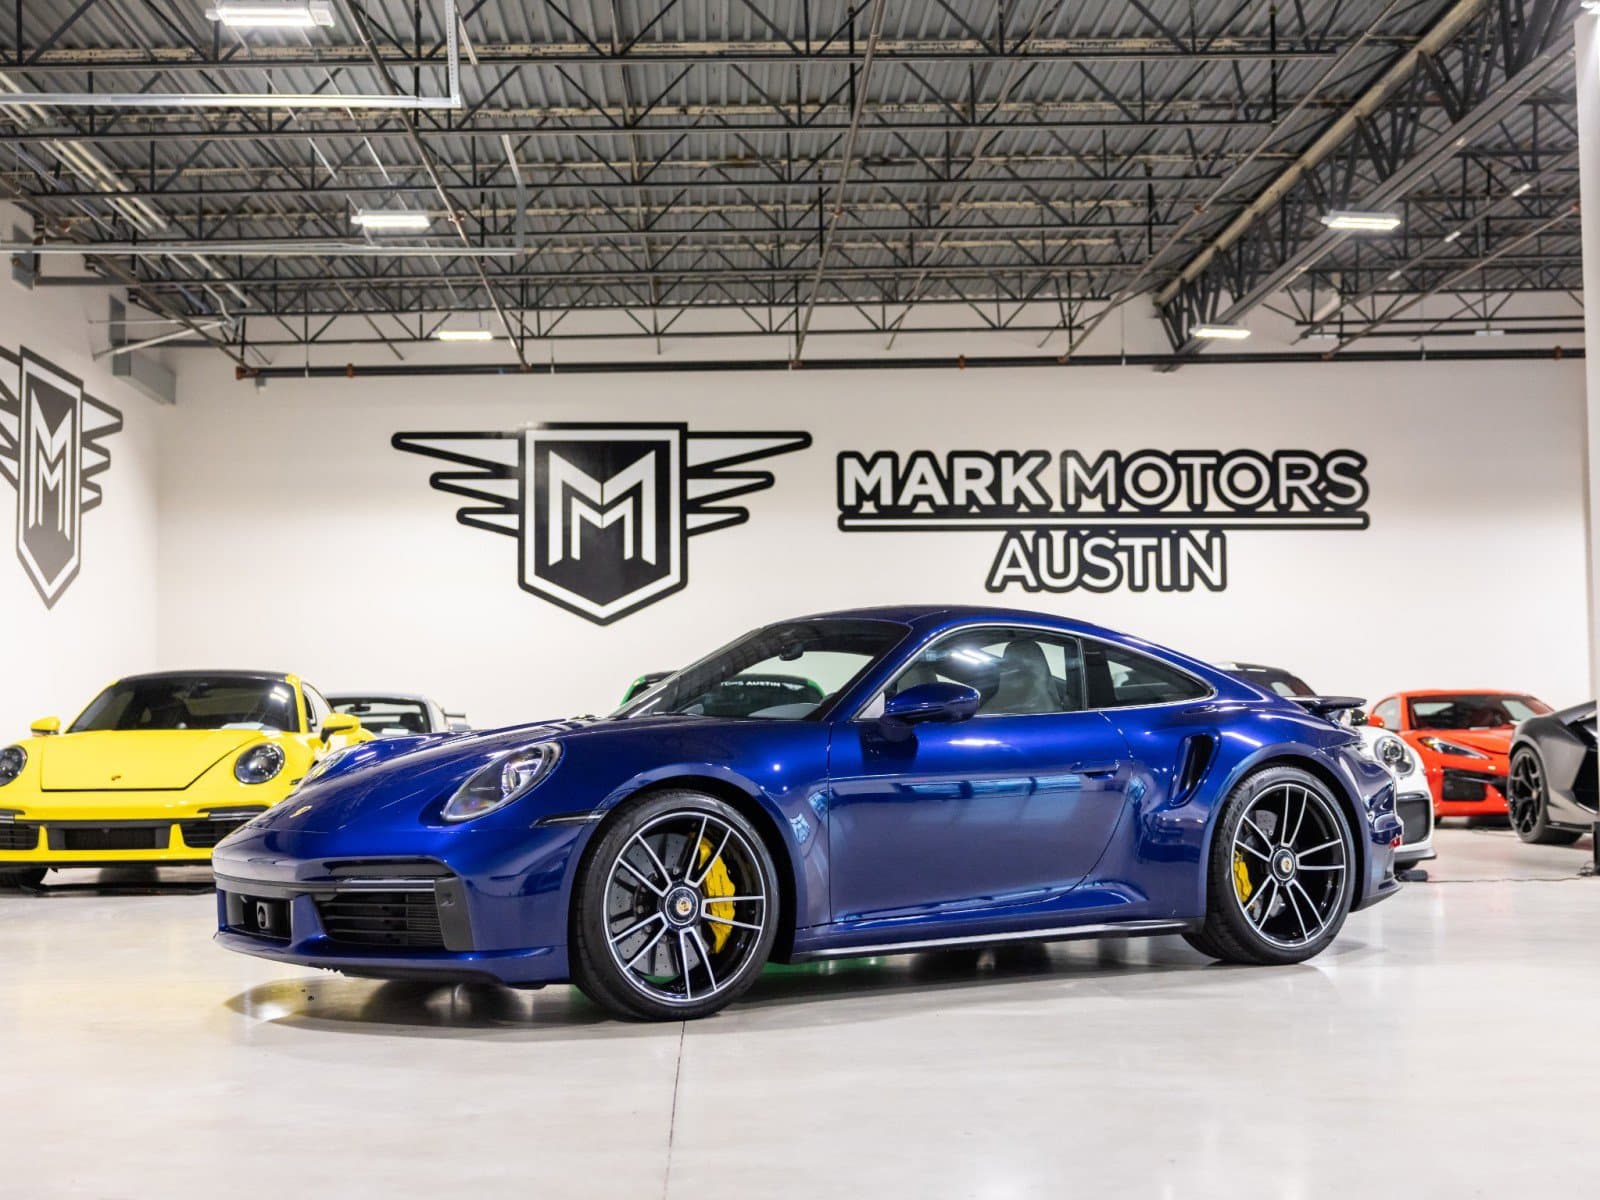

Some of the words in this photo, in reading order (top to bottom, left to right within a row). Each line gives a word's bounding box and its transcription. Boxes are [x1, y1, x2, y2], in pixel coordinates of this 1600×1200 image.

[840, 454, 1049, 509] MARK
[1064, 453, 1366, 509] MOTORS
[989, 533, 1224, 590] AUSTIN
